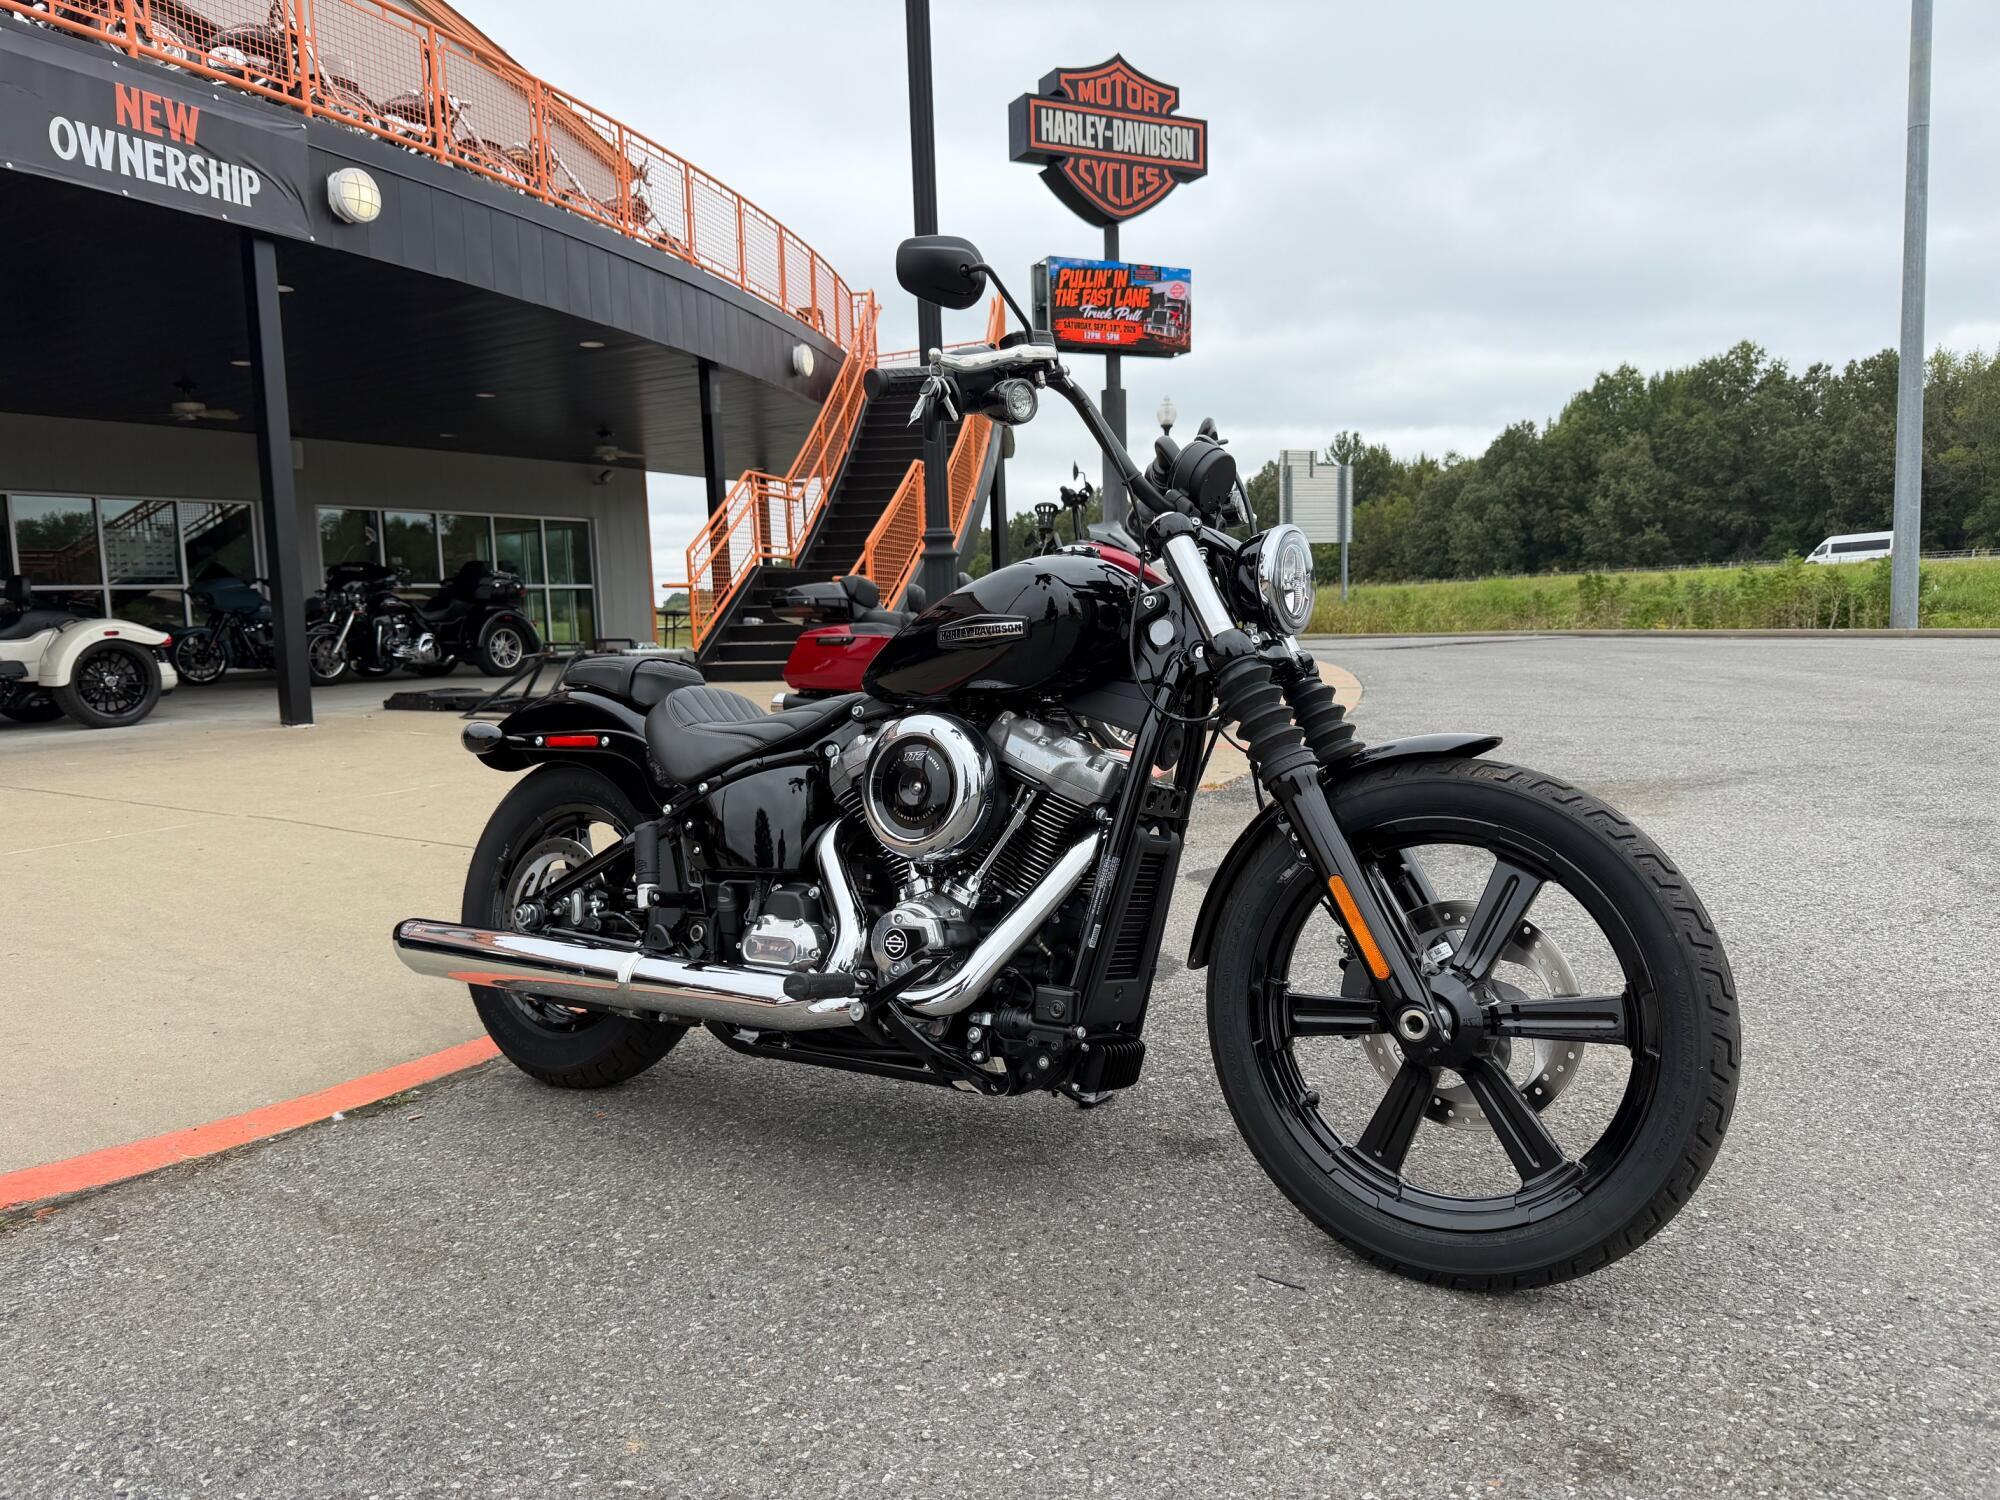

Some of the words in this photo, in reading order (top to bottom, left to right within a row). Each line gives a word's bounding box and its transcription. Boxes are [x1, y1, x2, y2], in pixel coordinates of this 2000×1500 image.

[1078, 71, 1159, 113] MOTOR
[114, 82, 200, 146] NEW
[1041, 107, 1194, 161] HARLEY-DAVIDSON
[49, 116, 261, 207] OWNERSHIP
[1079, 158, 1160, 206] CYCLES
[1059, 268, 1111, 289] PULLIN'
[1113, 269, 1128, 288] IN
[1055, 288, 1080, 307] THE
[1081, 288, 1113, 308] FAST
[1115, 287, 1151, 309] LANE
[1079, 304, 1113, 319] Truck
[1114, 306, 1143, 321] Pull
[940, 623, 1023, 641] HARLEY-DAVIDSON
[902, 750, 930, 762] 117
